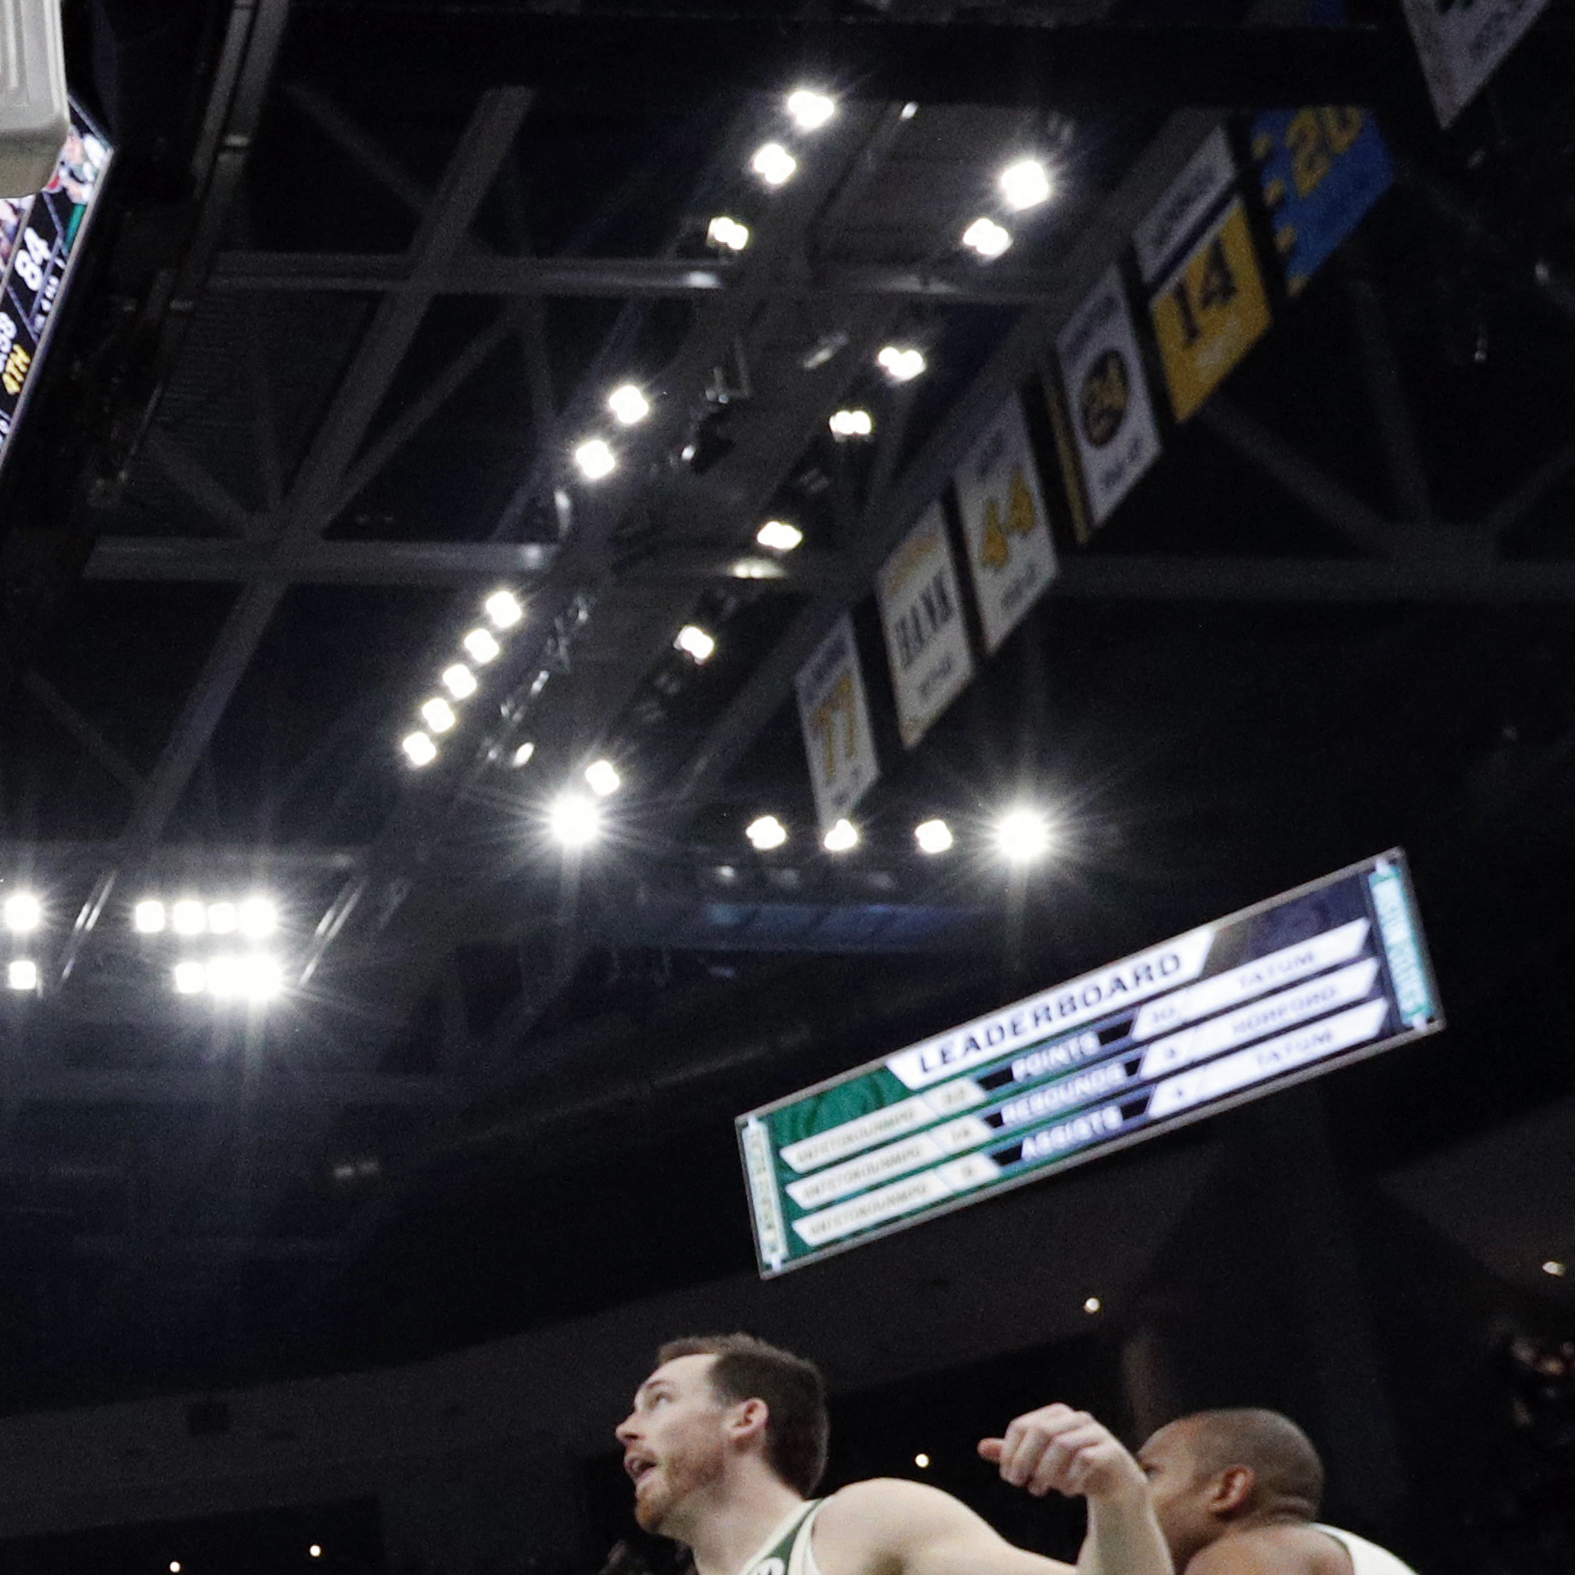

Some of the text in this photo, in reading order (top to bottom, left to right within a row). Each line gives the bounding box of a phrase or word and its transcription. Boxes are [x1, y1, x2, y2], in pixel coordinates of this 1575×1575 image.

[15, 227, 49, 291] 84
[1177, 238, 1237, 341] 14
[2, 344, 31, 396] 4TH
[920, 953, 1181, 1074] LEADERBOARD
